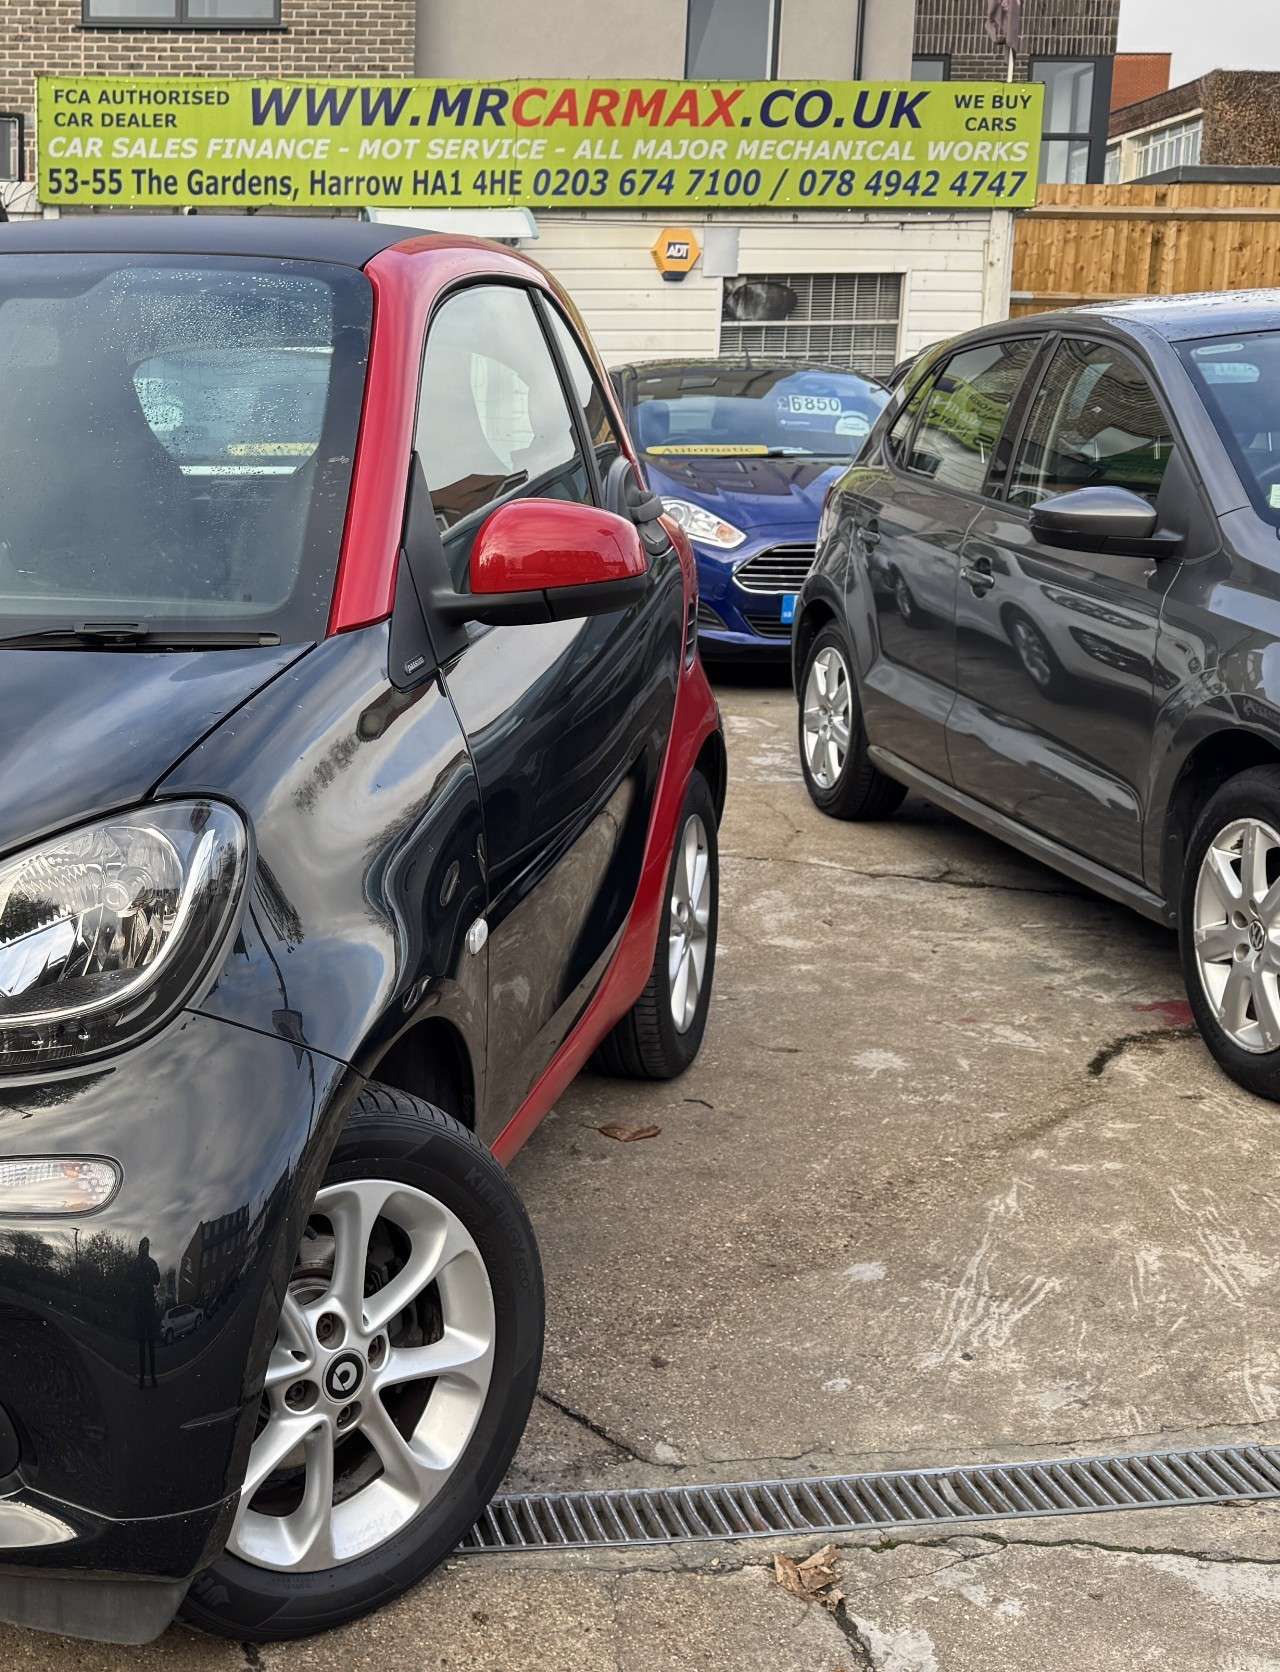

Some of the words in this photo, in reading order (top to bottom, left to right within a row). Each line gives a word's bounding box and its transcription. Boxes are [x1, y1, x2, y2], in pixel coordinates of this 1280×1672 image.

[54, 89, 91, 104] FCA
[98, 89, 230, 105] AUTHORISED
[954, 94, 984, 109] WE
[991, 95, 1032, 110] BUY
[251, 87, 931, 129] WWW.MRCARMAX.CO.UK
[54, 112, 93, 128] CAR
[101, 113, 177, 128] DEALER
[965, 117, 1017, 132] CARS
[47, 136, 103, 158] CAR
[111, 136, 199, 159] SALES
[206, 137, 330, 160] FINANCE
[358, 138, 421, 160] MOT
[426, 138, 548, 160] SERVICE
[573, 138, 624, 160] ALL
[632, 139, 726, 160] MAJOR
[735, 139, 915, 161] MECHANICAL
[927, 141, 1030, 162] WORKS
[48, 168, 123, 195] 53-55
[131, 168, 178, 195] The
[187, 168, 299, 201] Gardens,
[310, 169, 403, 196] Harrow
[412, 169, 462, 196] HA1
[472, 169, 523, 196] 4HE
[532, 168, 609, 197] 0203
[619, 168, 675, 196] 674
[685, 168, 761, 197] 7100
[769, 168, 790, 201] /
[799, 168, 856, 197] 078
[864, 169, 940, 197] 4942
[949, 170, 1028, 198] 4747
[666, 243, 689, 258] ADT
